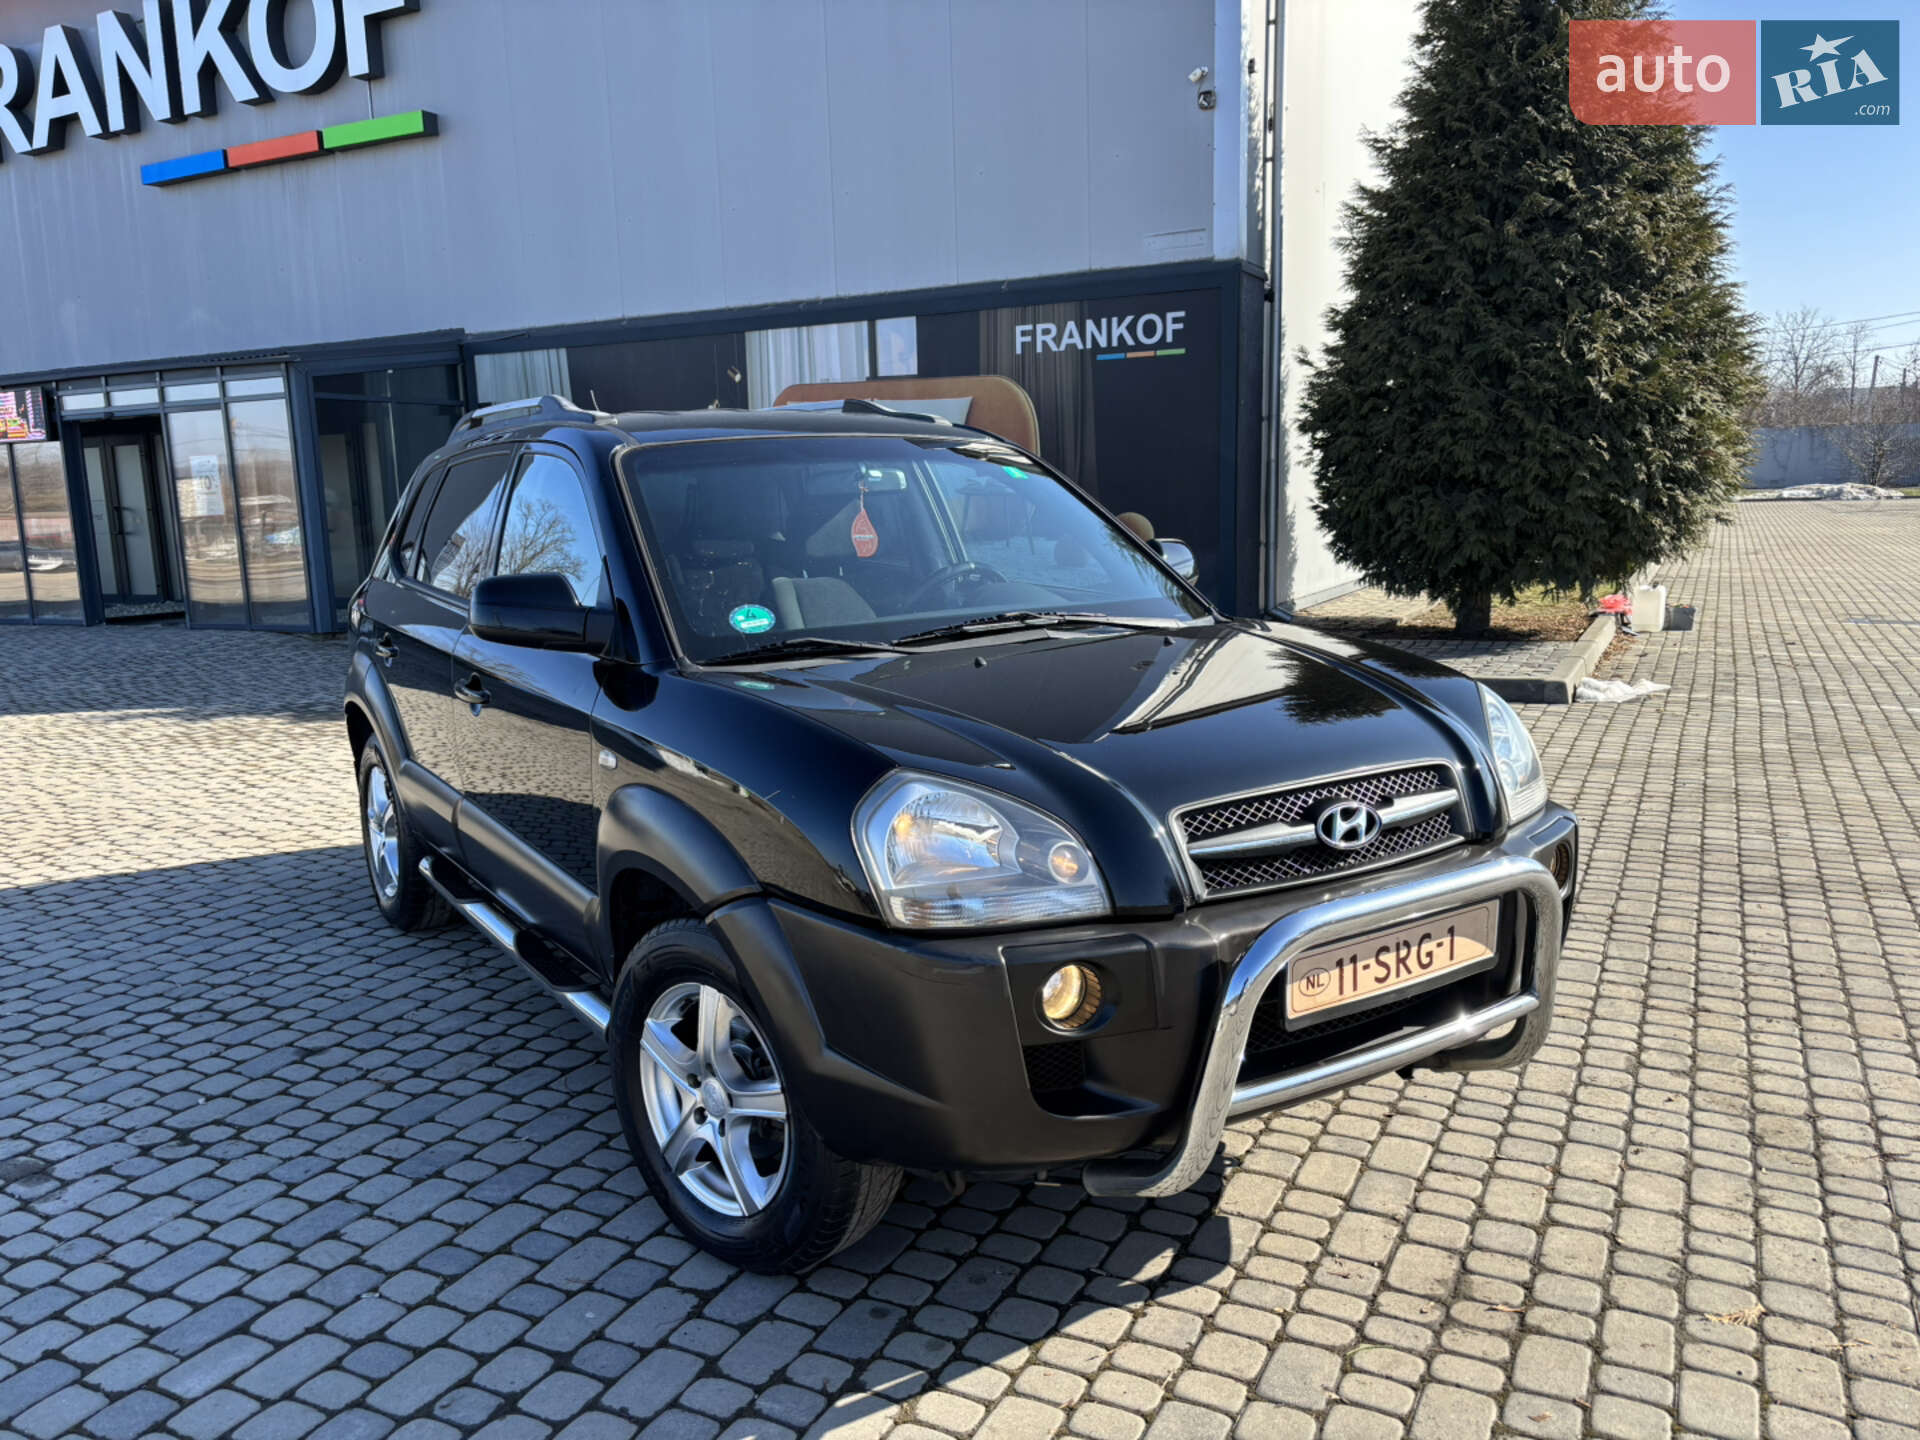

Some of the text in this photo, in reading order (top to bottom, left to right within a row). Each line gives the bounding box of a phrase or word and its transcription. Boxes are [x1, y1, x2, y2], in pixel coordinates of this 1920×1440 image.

[1015, 310, 1186, 355] FRANKOF
[1305, 925, 1456, 996] NL 11-SRG-1
